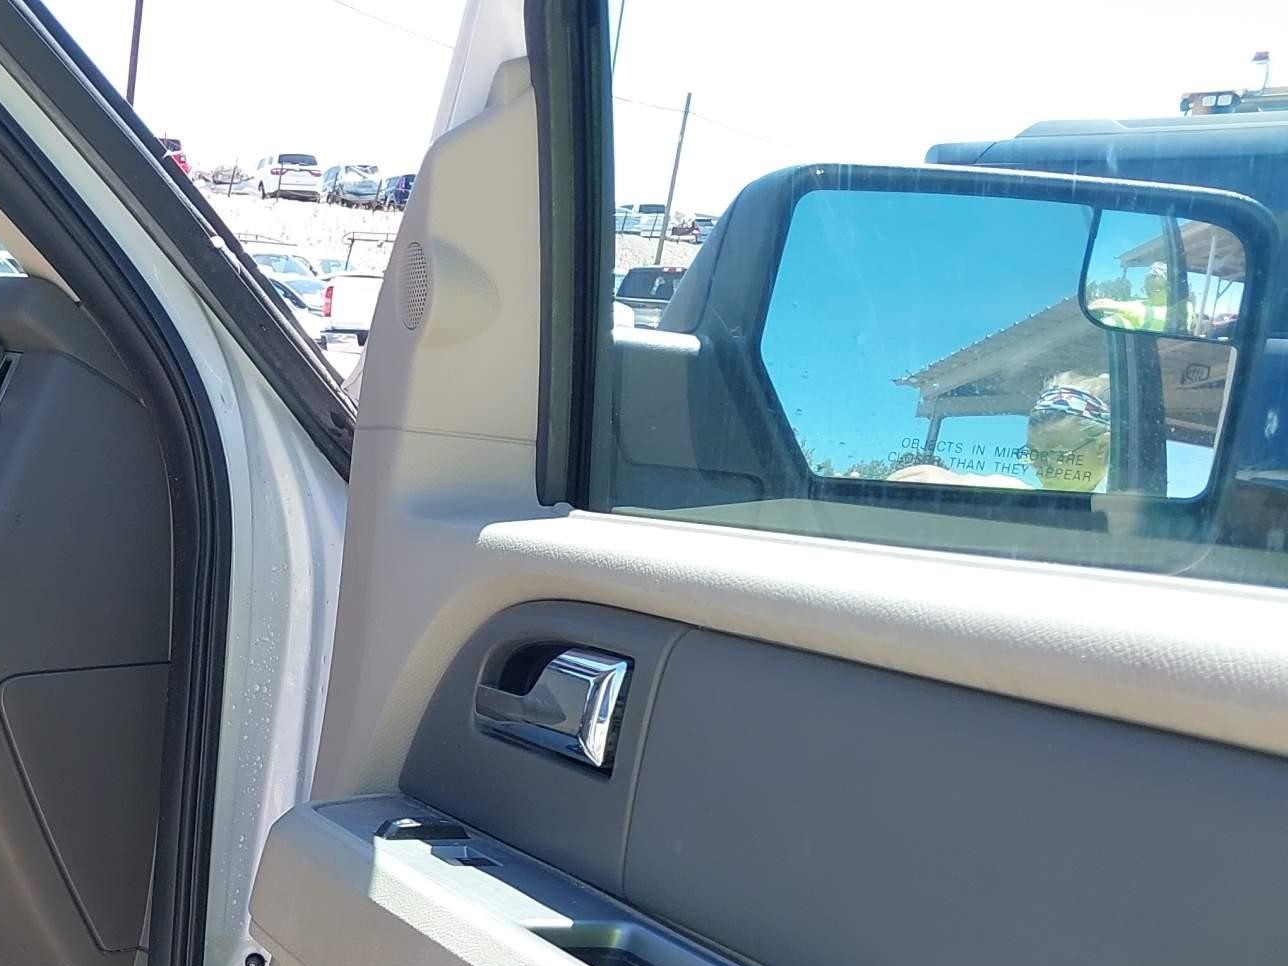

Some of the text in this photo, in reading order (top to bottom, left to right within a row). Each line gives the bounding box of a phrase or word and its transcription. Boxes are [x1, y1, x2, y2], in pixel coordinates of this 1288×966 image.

[887, 451, 1092, 482] CLOSER THAN THEY APPEAR
[901, 437, 1085, 467] OBJECTS IN MIRROR ARE
